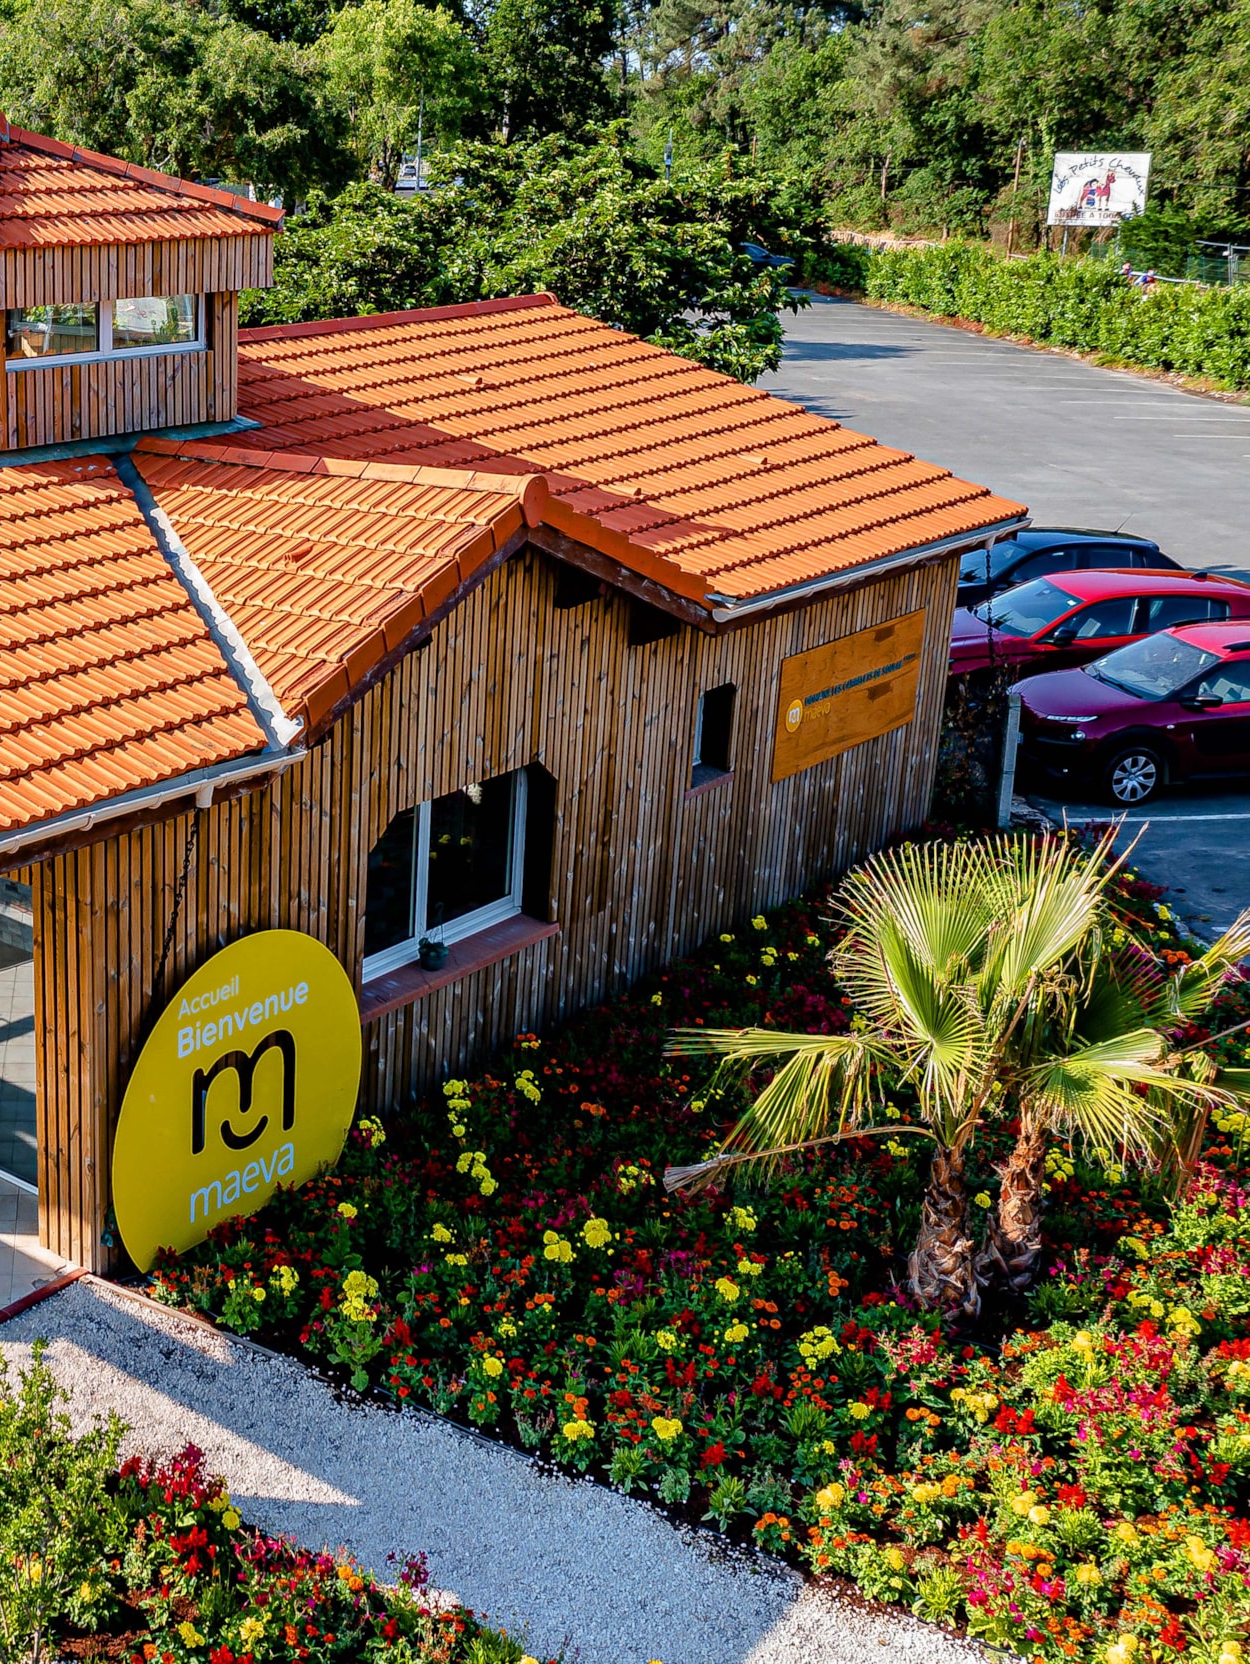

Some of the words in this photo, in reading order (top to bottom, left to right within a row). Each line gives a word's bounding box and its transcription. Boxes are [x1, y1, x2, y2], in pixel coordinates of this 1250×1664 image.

[1069, 155, 1105, 175] Petits
[804, 702, 831, 722] maeva
[178, 975, 239, 1020] Accueil
[177, 982, 308, 1059] Bienvenue
[189, 1143, 295, 1224] maeva
